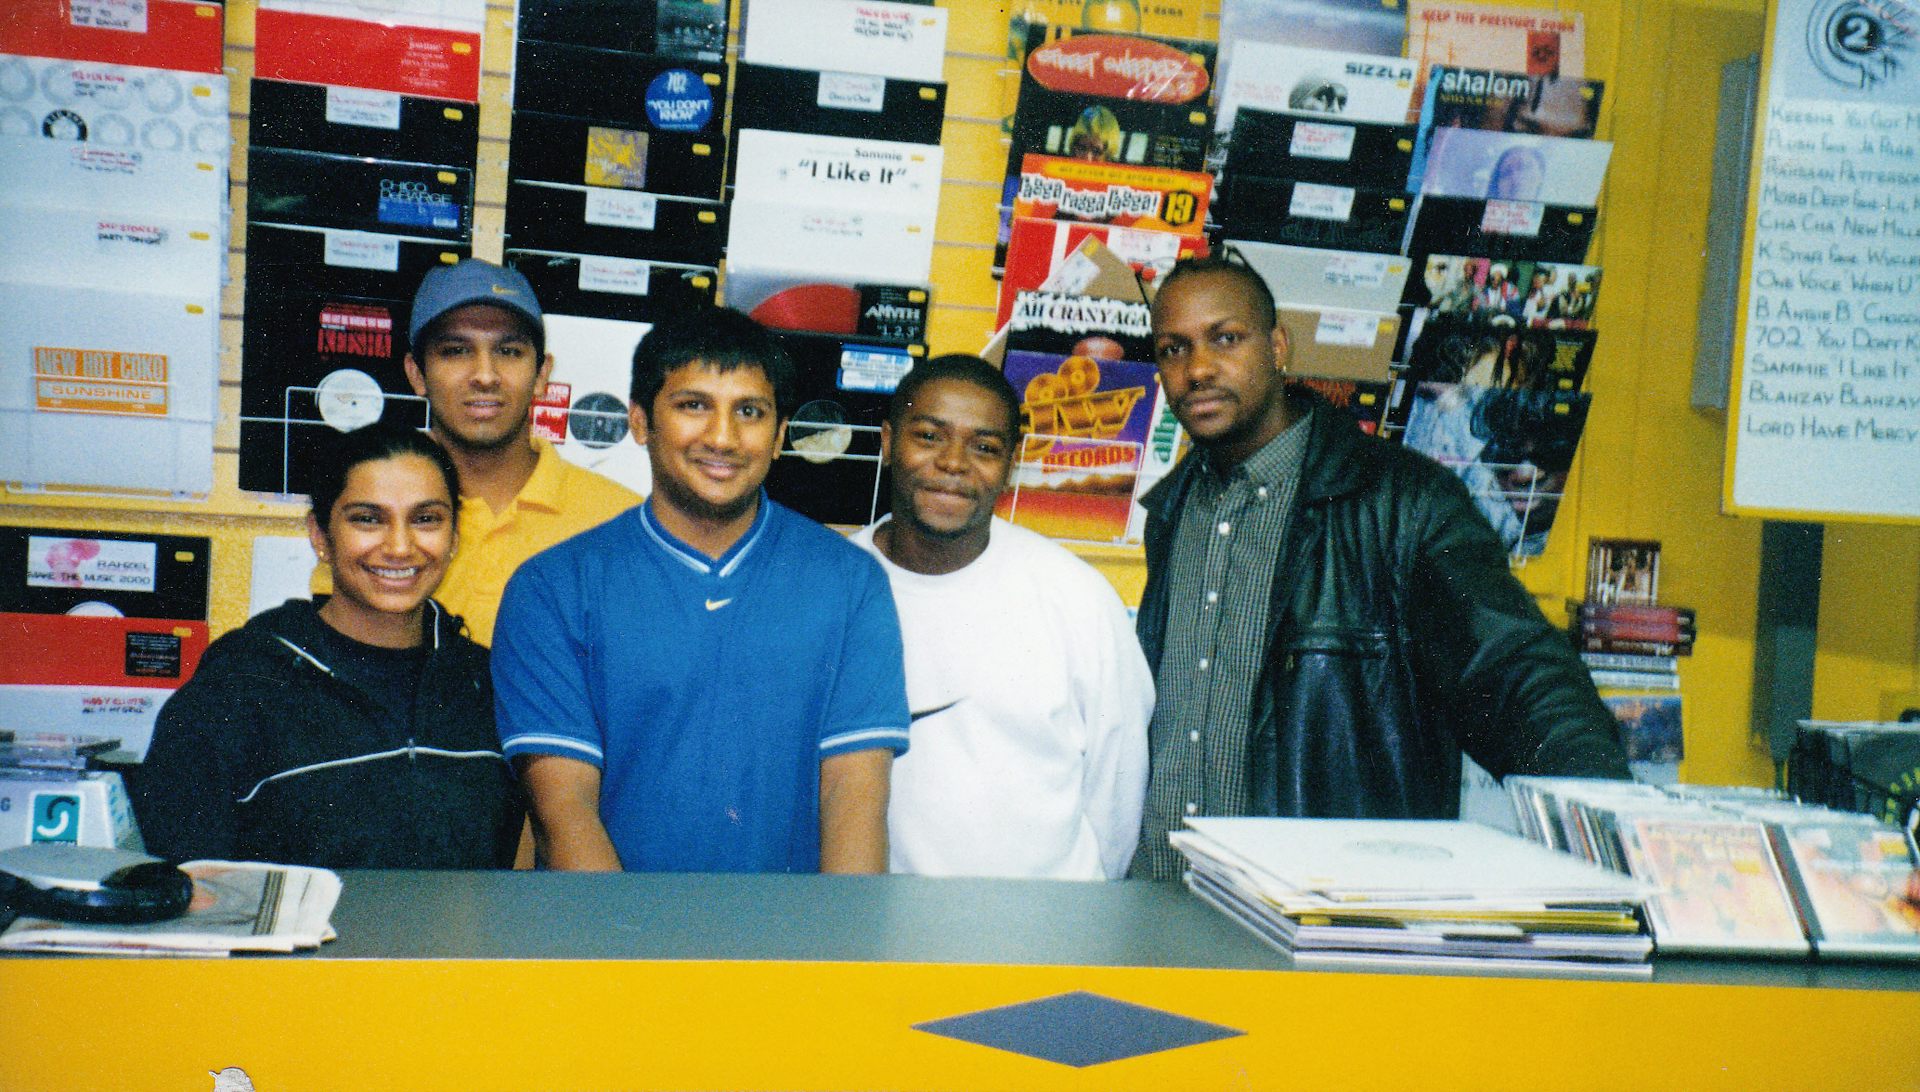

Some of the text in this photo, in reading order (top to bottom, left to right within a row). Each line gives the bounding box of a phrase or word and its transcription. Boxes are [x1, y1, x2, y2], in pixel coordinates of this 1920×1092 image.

[1455, 12, 1475, 24] THE
[1479, 14, 1536, 28] PRESSURE
[1541, 19, 1576, 33] DOWN
[1845, 16, 1869, 47] 2
[1346, 62, 1412, 80] SIZZLA
[1442, 67, 1529, 97] shalom
[668, 72, 688, 94] 702
[855, 147, 902, 161] Sammie
[827, 163, 870, 182] Like
[380, 179, 427, 194] CHICO
[1759, 211, 1796, 231] CHA
[1802, 212, 1834, 233] CHA
[98, 233, 123, 242] PARTY
[1756, 268, 1793, 290] ONE
[1799, 269, 1841, 292] VOICE
[1020, 303, 1045, 318] AH
[1756, 325, 1804, 347] 702
[40, 349, 75, 375] NEW
[83, 351, 113, 378] HOT
[1752, 353, 1828, 377] SAMMIE
[1850, 359, 1886, 378] LIKE
[52, 385, 152, 400] SUNSHINE
[1747, 415, 1919, 442] LORD HAVE MERCY
[1042, 446, 1136, 471] RECORDS
[61, 572, 79, 581] THE
[84, 574, 115, 583] MUSIC
[119, 576, 151, 585] 2000
